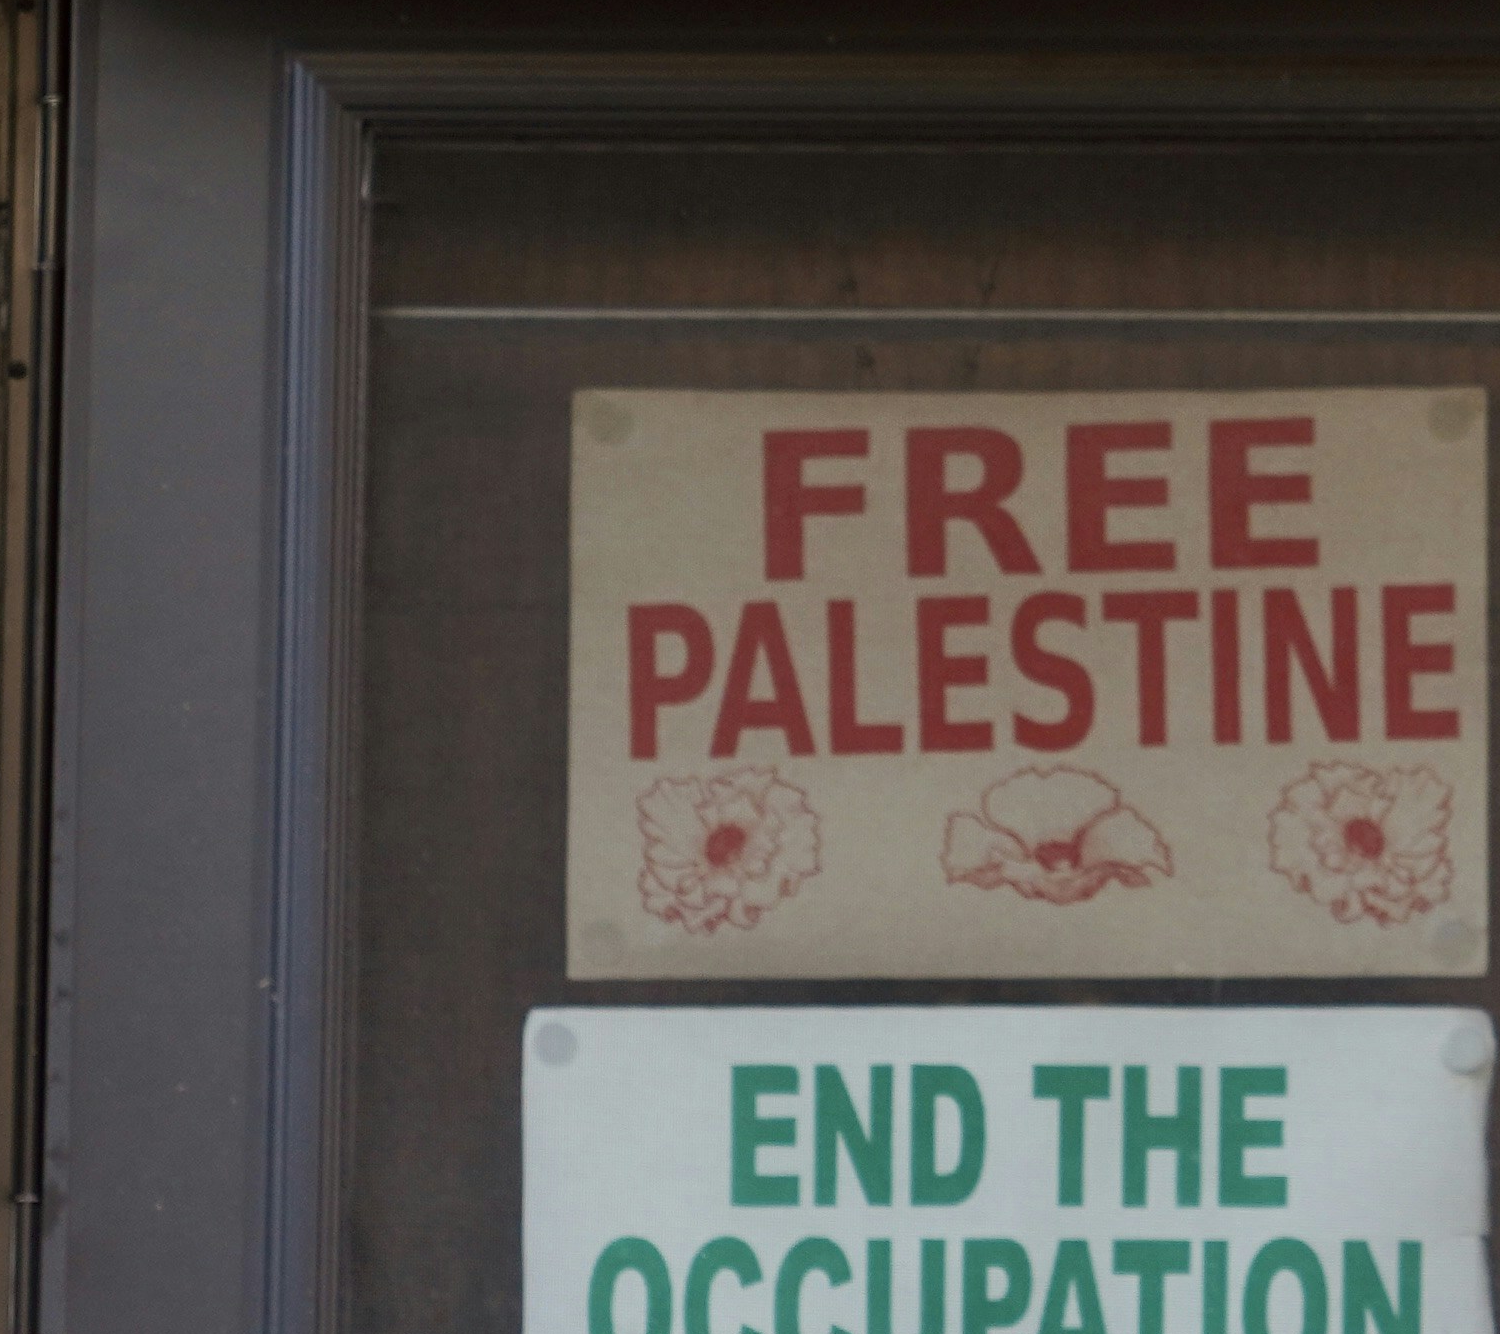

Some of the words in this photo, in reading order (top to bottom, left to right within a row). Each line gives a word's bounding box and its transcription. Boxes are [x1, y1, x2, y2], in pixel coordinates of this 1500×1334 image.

[762, 416, 1320, 581] FREE
[628, 583, 1461, 760] PALESTINE
[730, 1064, 986, 1207] END
[1033, 1064, 1288, 1207] THE
